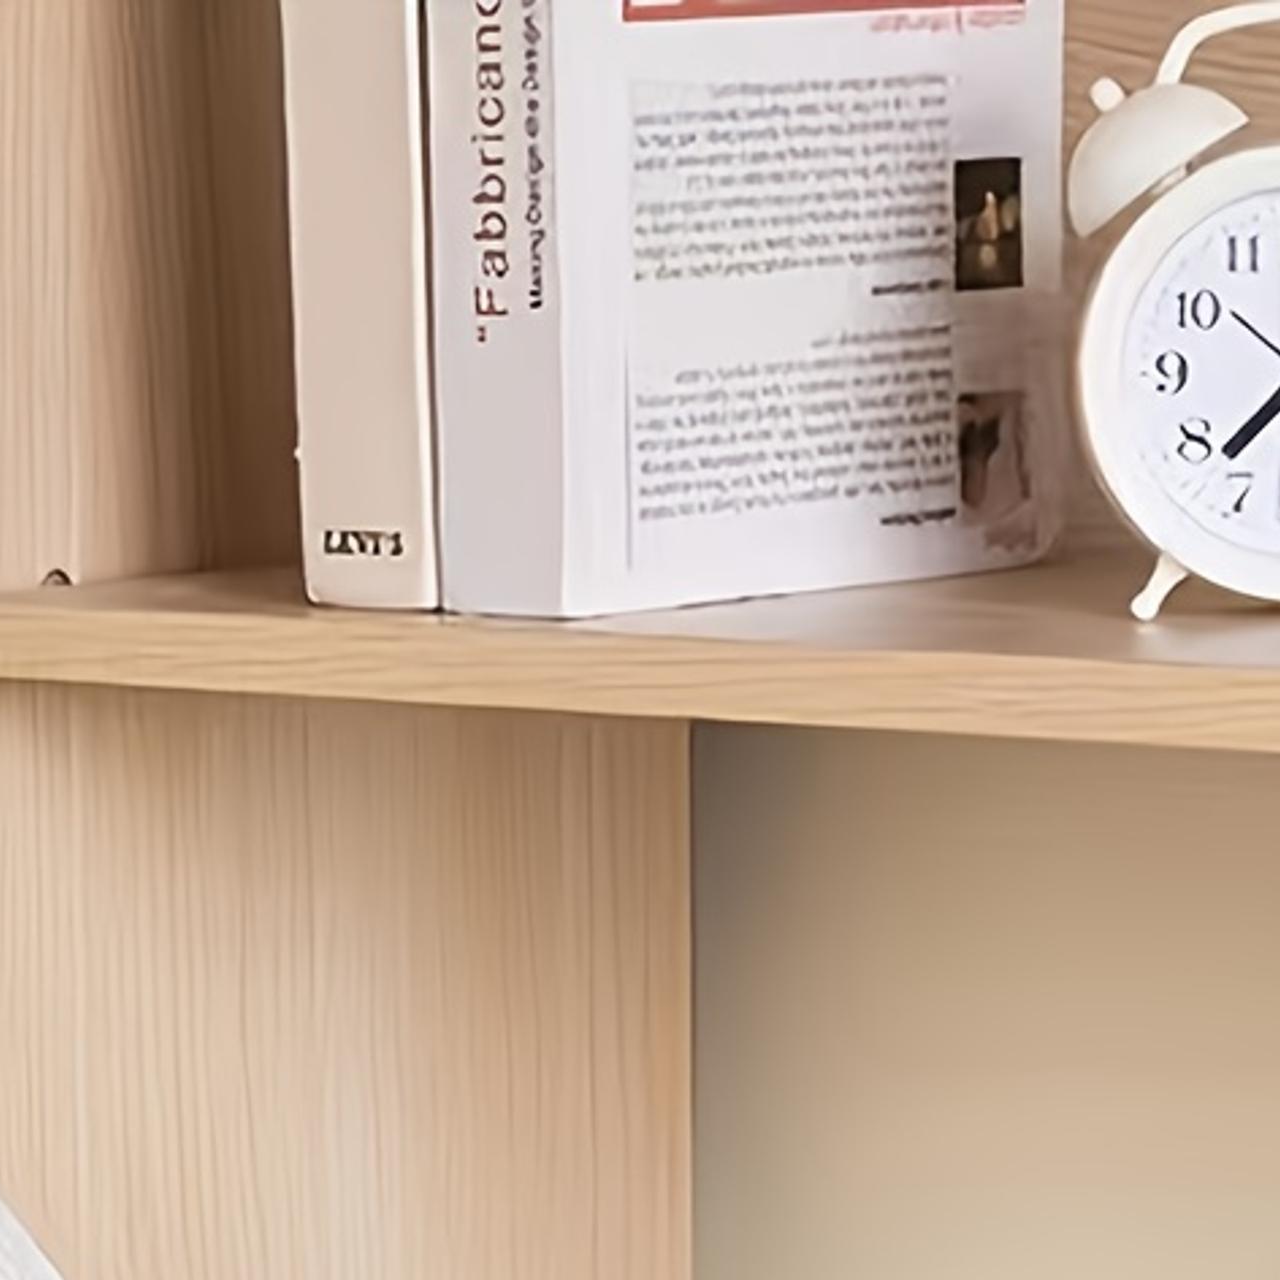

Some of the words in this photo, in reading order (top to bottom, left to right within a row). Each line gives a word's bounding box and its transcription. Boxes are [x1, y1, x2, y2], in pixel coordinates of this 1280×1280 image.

[1227, 235, 1259, 273] 11
[1176, 288, 1222, 331] 10
[1154, 349, 1189, 396] 9
[1176, 415, 1213, 465] 8
[1225, 471, 1255, 514] 7
